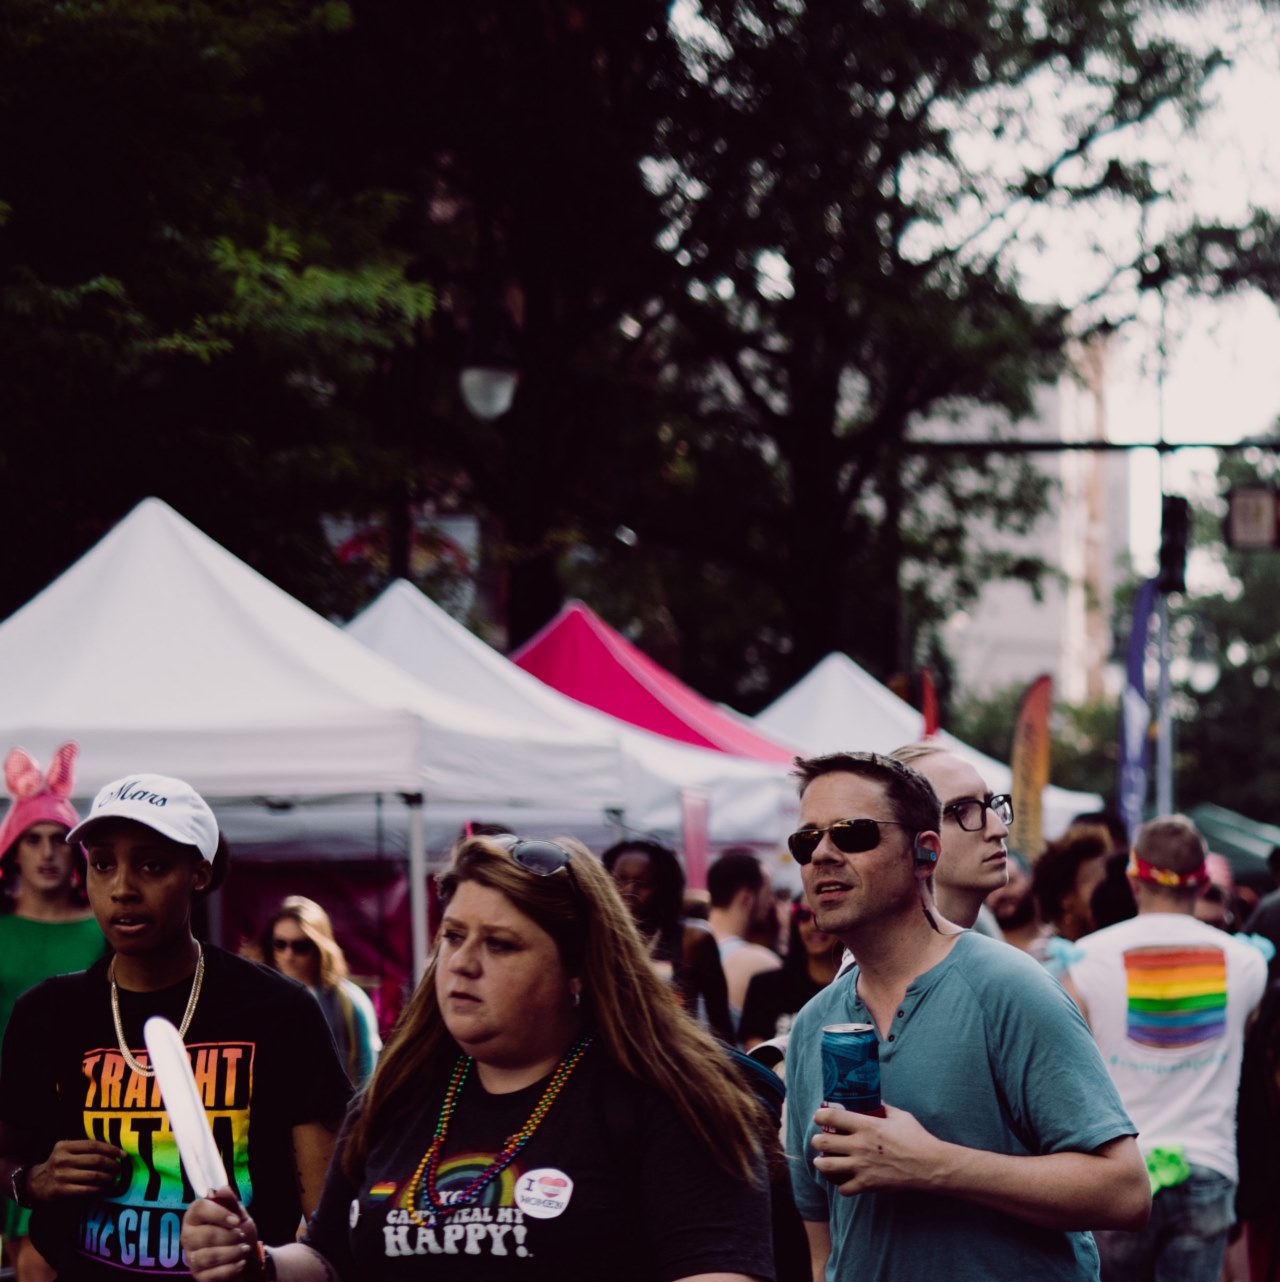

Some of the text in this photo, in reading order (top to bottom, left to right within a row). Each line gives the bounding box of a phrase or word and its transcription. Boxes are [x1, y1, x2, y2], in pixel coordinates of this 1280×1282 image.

[98, 780, 168, 808] Mars
[520, 1194, 564, 1211] WOMEN
[382, 1223, 528, 1258] HAPPY!
